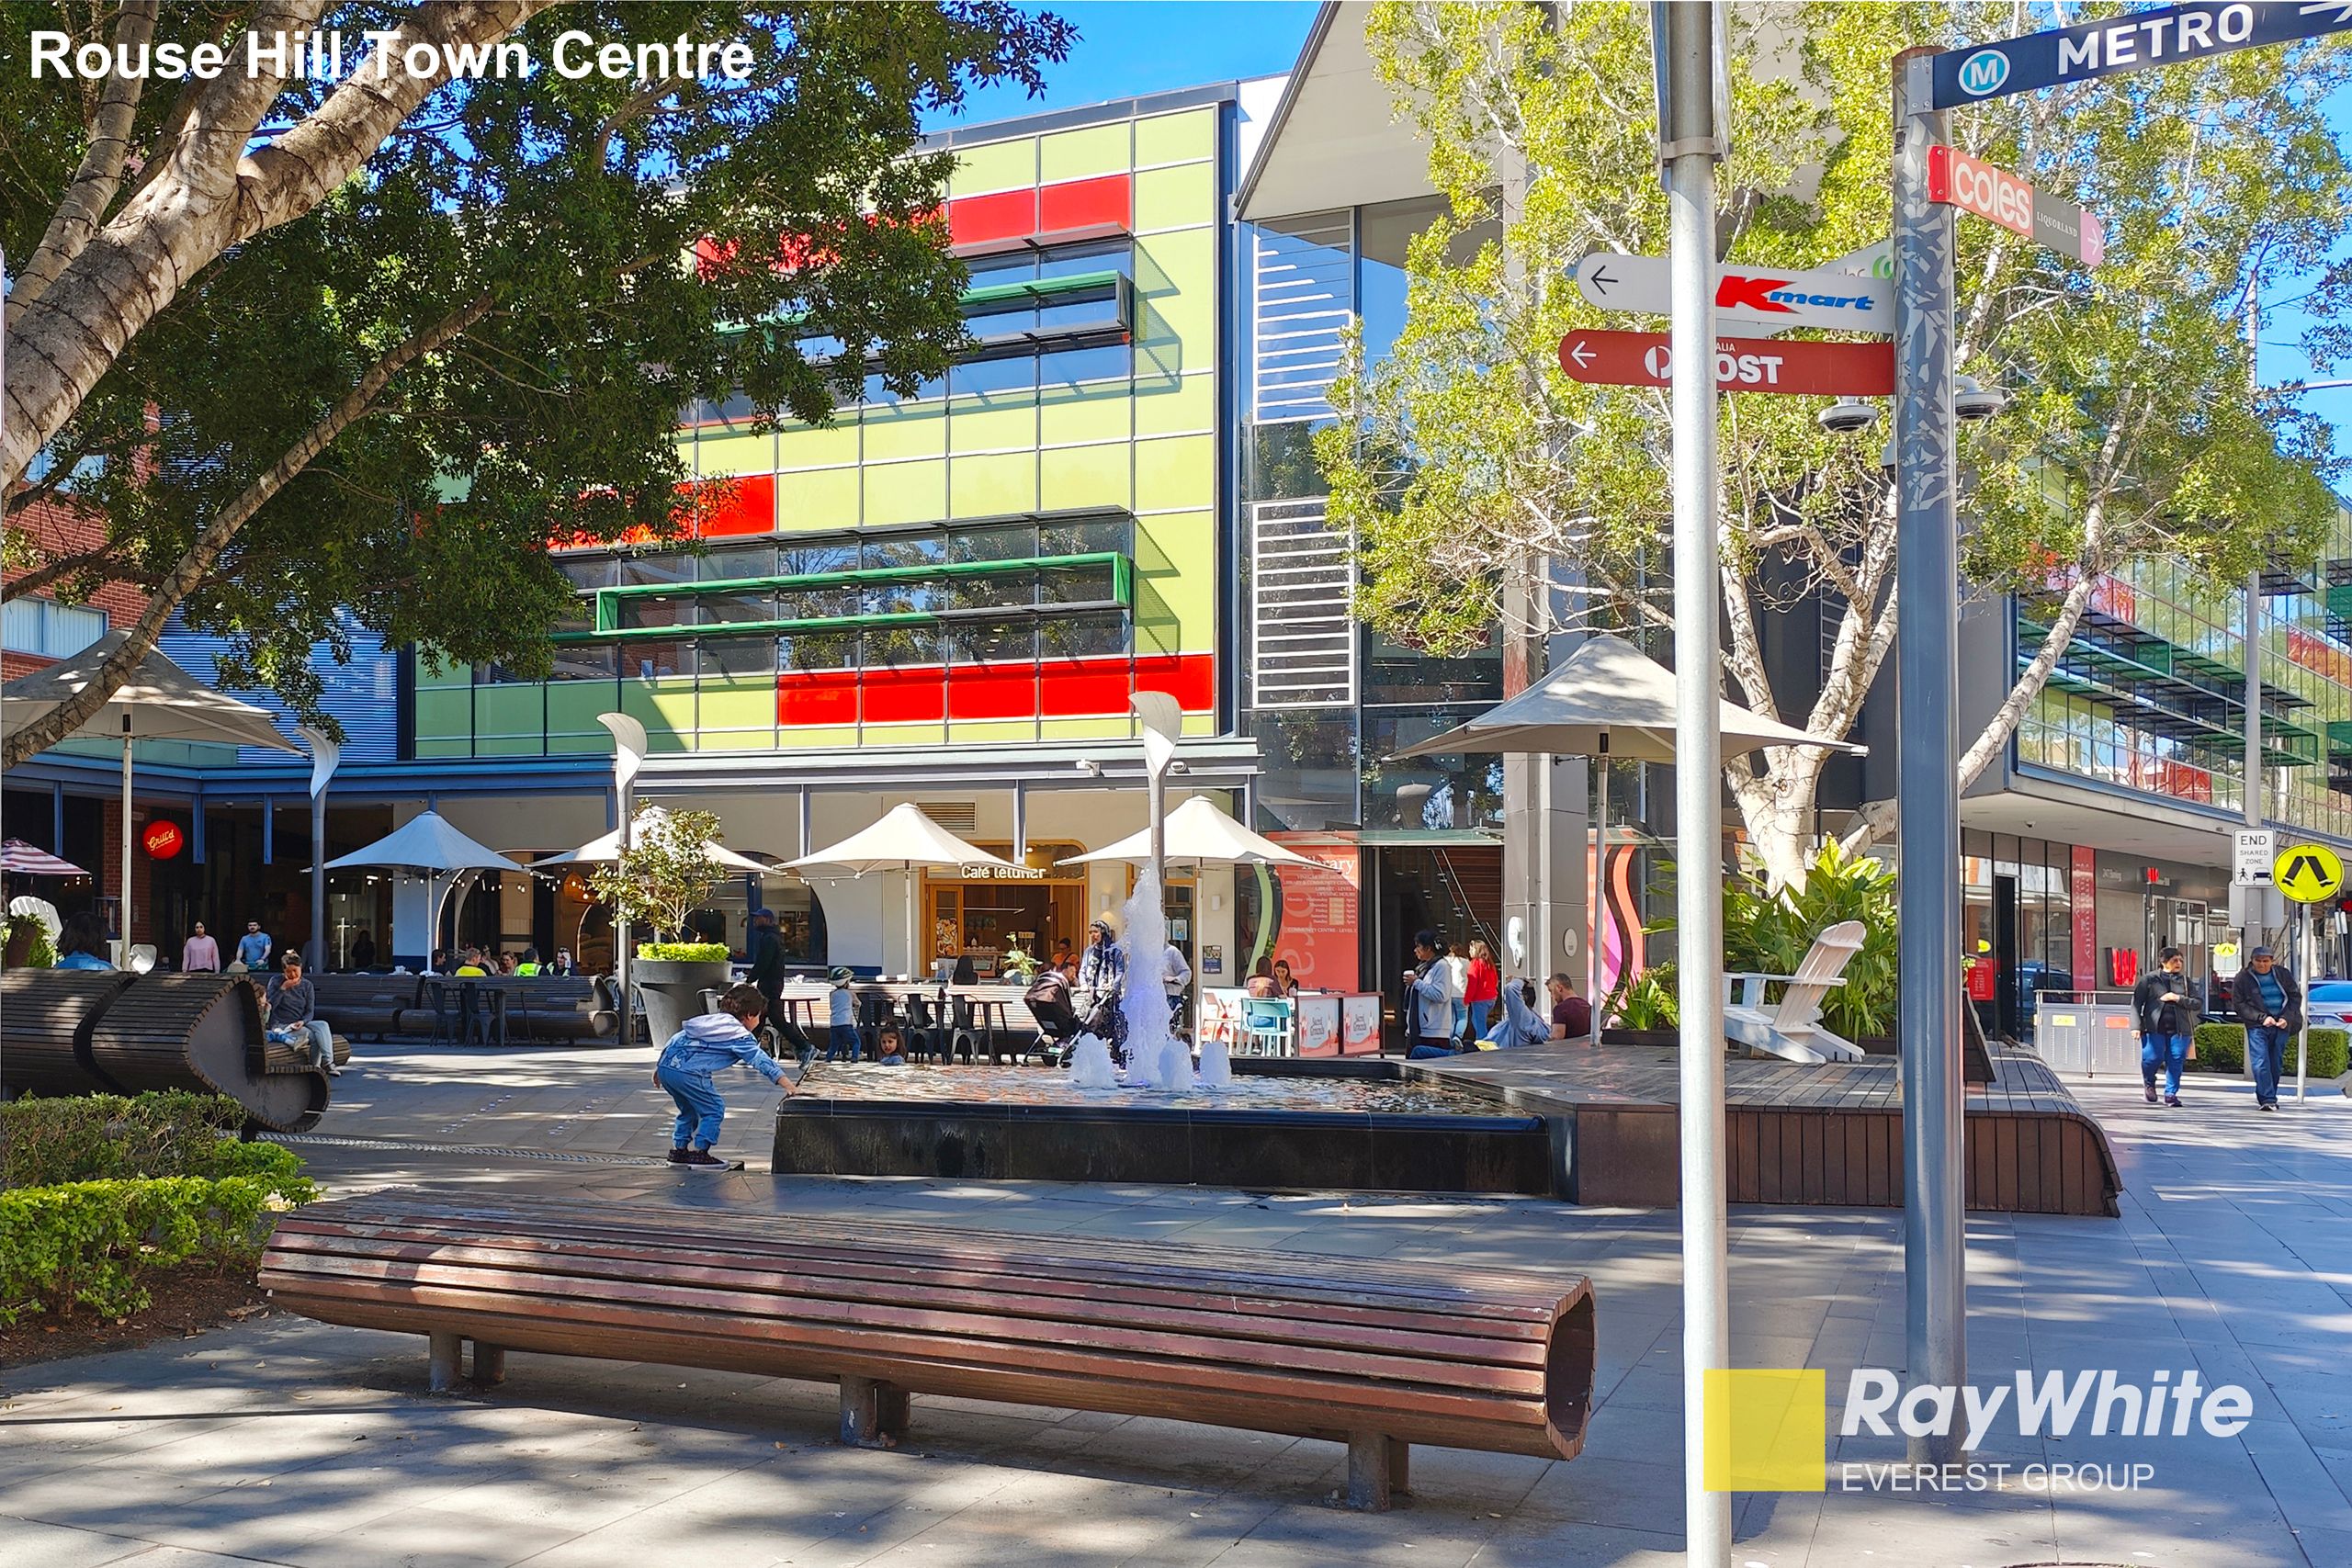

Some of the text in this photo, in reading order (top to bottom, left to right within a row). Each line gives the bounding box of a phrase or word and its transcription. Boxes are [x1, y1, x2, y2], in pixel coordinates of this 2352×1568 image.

[2058, 3, 2255, 75] METRO
[1954, 162, 2030, 230] coles
[1715, 276, 1875, 315] Kmart
[1716, 354, 1783, 384] OST
[2240, 835, 2267, 846] END
